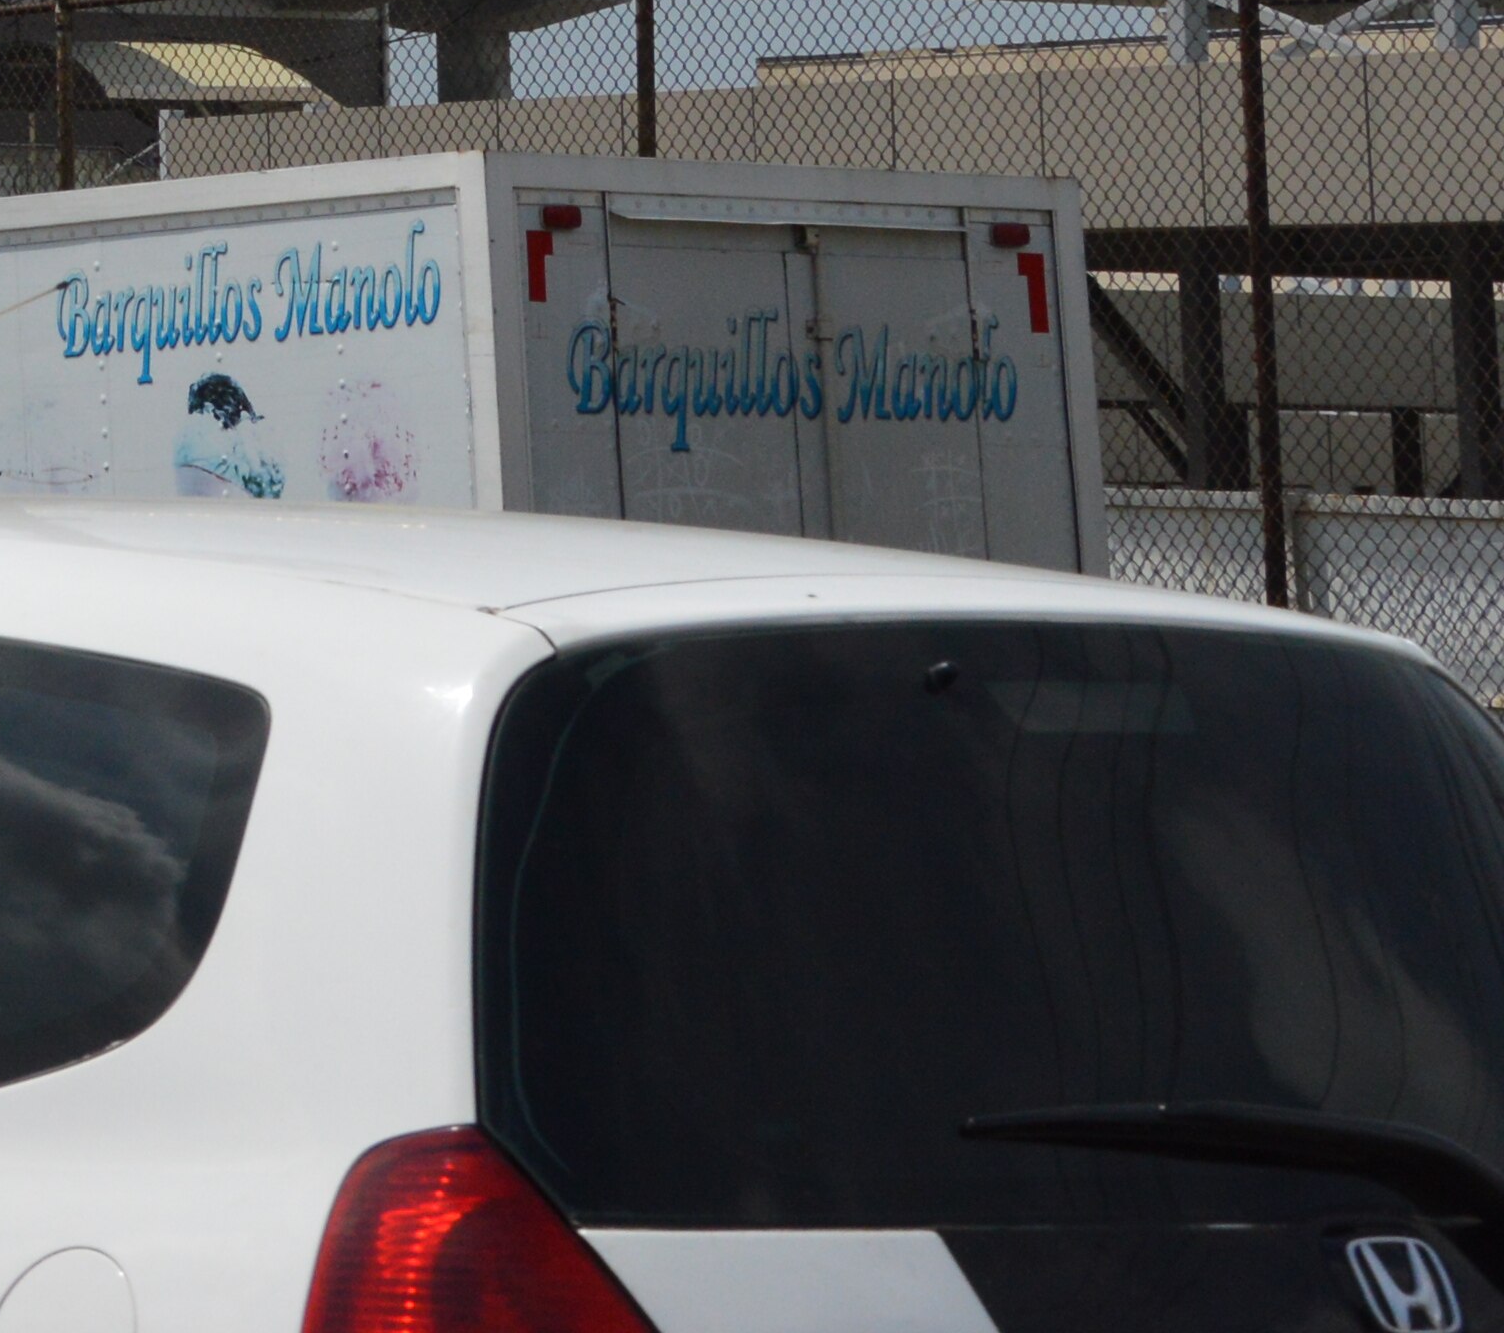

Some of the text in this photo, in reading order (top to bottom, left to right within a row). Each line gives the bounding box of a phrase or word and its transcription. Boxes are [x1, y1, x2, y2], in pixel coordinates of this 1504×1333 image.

[56, 218, 441, 385] Barquillos Manolo
[566, 306, 1018, 452] Barquillos Manolo
